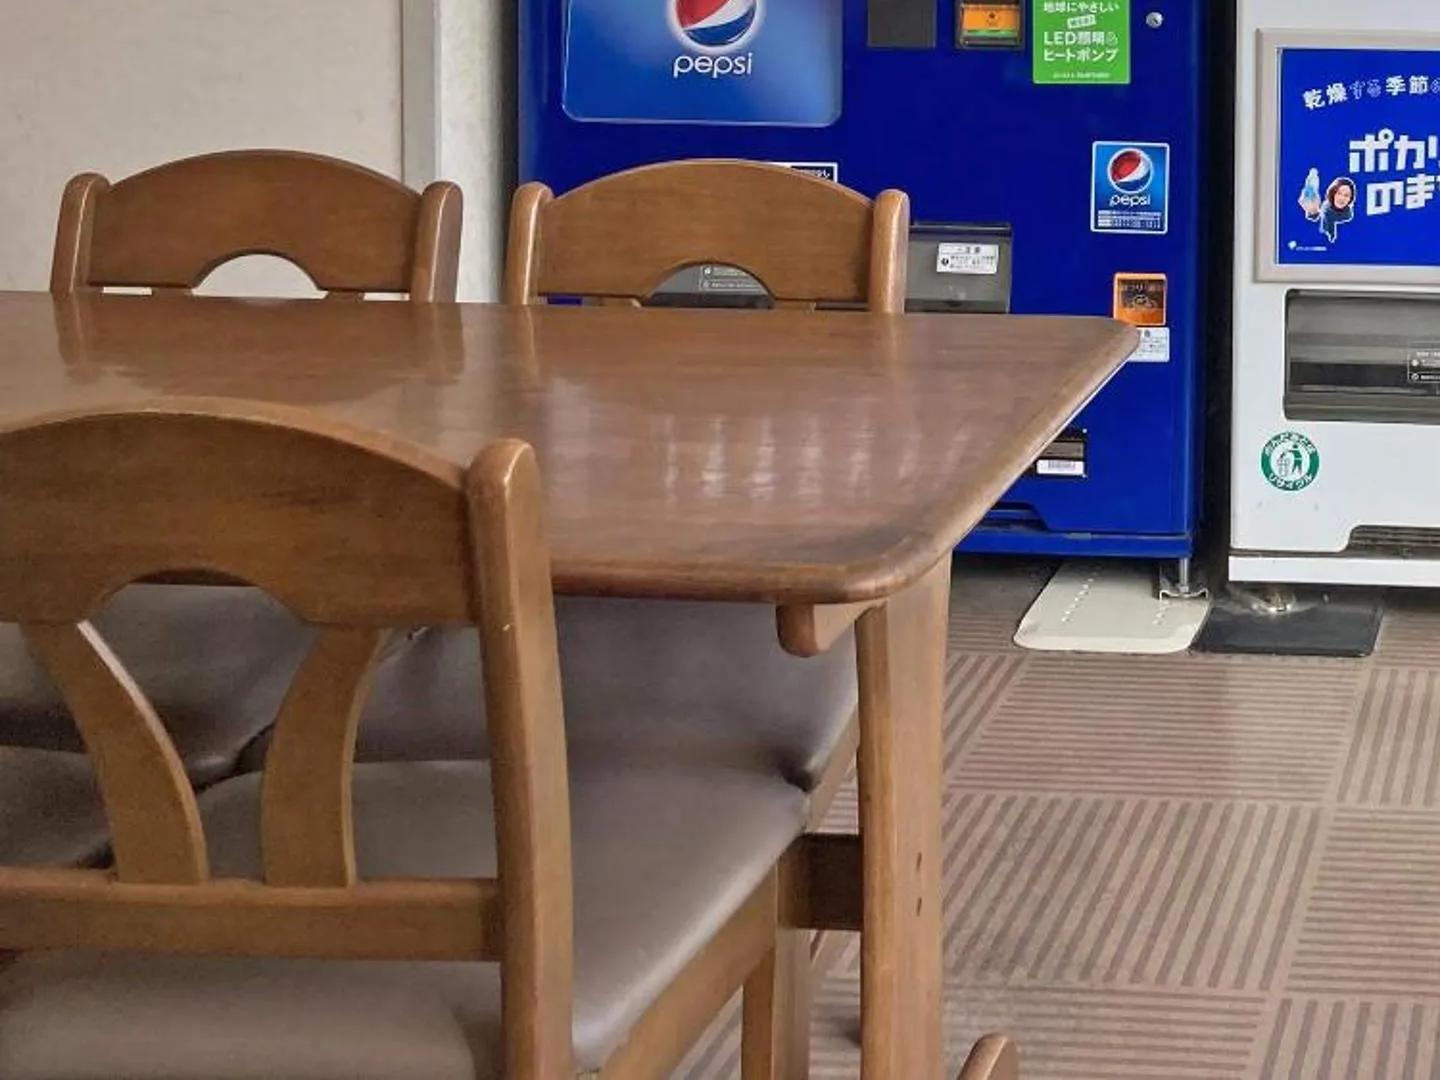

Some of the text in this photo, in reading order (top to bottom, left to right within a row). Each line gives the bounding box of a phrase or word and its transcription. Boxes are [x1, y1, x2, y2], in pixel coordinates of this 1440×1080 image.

[1043, 1, 1120, 14] 地球にやさしい
[1043, 48, 1119, 62] ヒートポンプ
[673, 52, 753, 79] pepsi
[1109, 193, 1151, 208] pepsi
